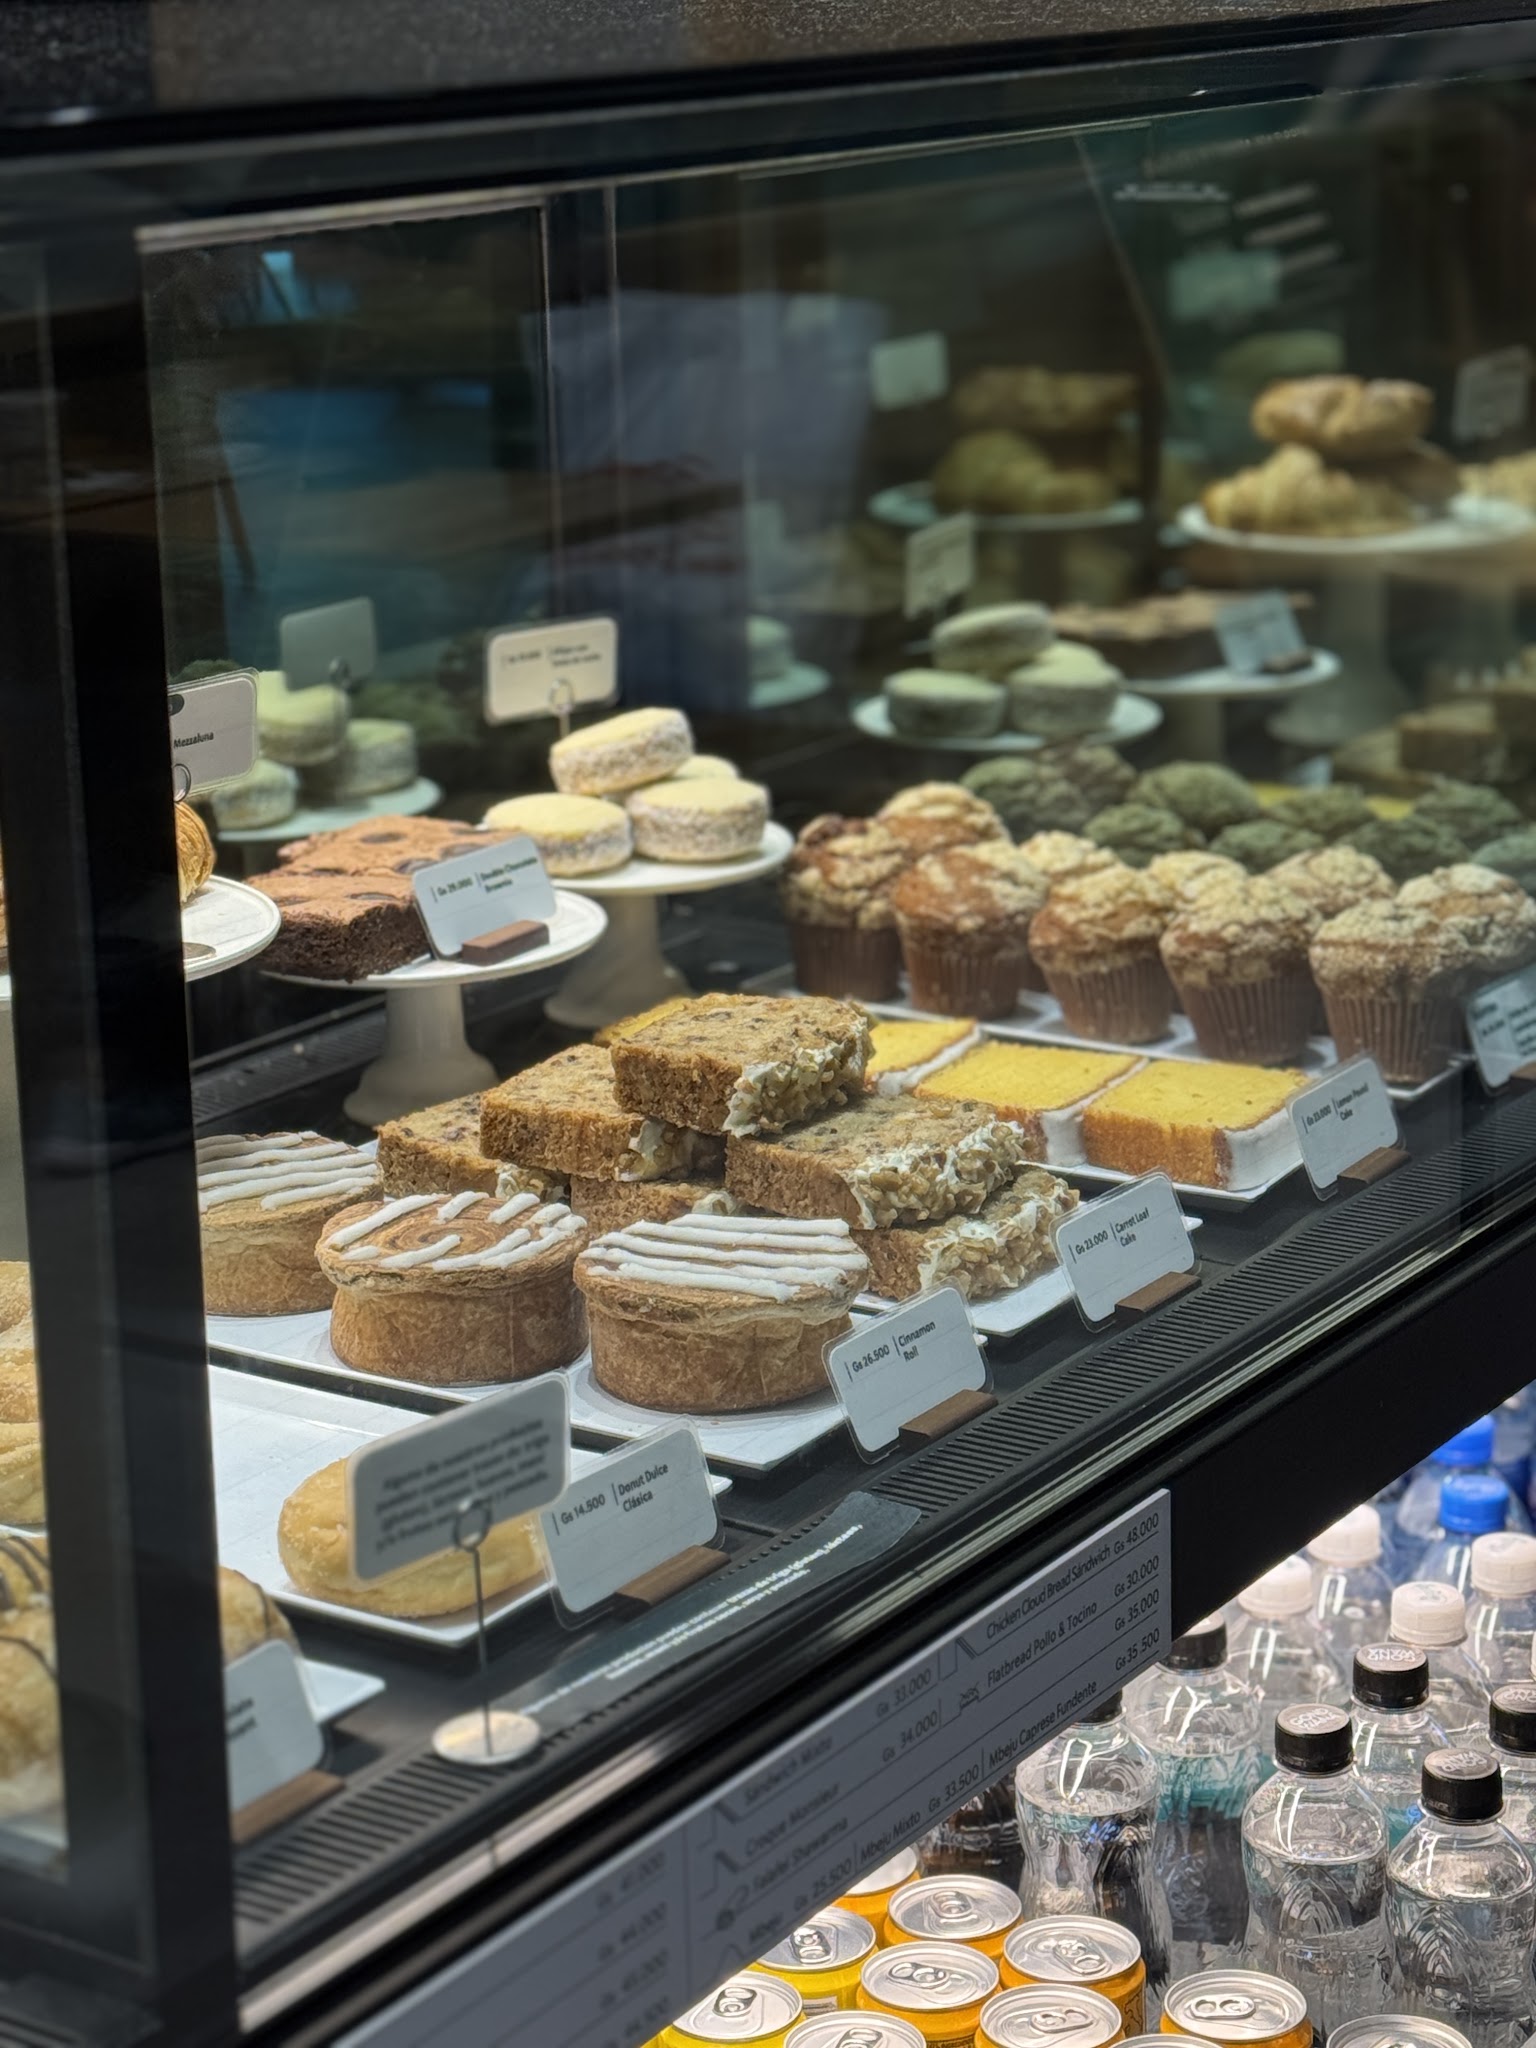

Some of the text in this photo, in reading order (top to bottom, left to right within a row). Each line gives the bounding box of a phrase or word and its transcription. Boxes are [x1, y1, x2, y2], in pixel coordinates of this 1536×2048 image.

[173, 732, 214, 748] Mezzaluna
[1340, 1108, 1353, 1121] Cake
[1115, 1207, 1150, 1234] Carrot Loaf
[1075, 1230, 1108, 1255] Gs 23.000
[1120, 1232, 1136, 1248] Cake
[898, 1321, 936, 1347] Cinnamon
[852, 1344, 890, 1373] Gs 26.500
[903, 1345, 919, 1362] Roll
[617, 1464, 668, 1496] Donut Dulce
[560, 1493, 606, 1525] Gs 14.500
[622, 1490, 653, 1513] Clásica
[986, 1608, 1022, 1640] Chicken
[1021, 1588, 1046, 1616] Cloud
[1046, 1569, 1071, 1598] Bread
[1113, 1540, 1125, 1554] Gs
[1126, 1513, 1159, 1544] 48.000
[1114, 1555, 1159, 1597] Gs 30.000
[1114, 1588, 1159, 1631] Gs 35.000
[987, 1602, 1097, 1687] Flatbread Pollo & Tocino
[1019, 1709, 1056, 1747] Caprese
[1056, 1680, 1097, 1721] Fundente
[1115, 1656, 1126, 1671] Gs
[882, 1747, 896, 1763] Gs
[900, 1710, 938, 1748] 34.000
[892, 1810, 921, 1839] Mixto
[928, 1797, 941, 1813] Gs
[945, 1763, 979, 1798] 33.500
